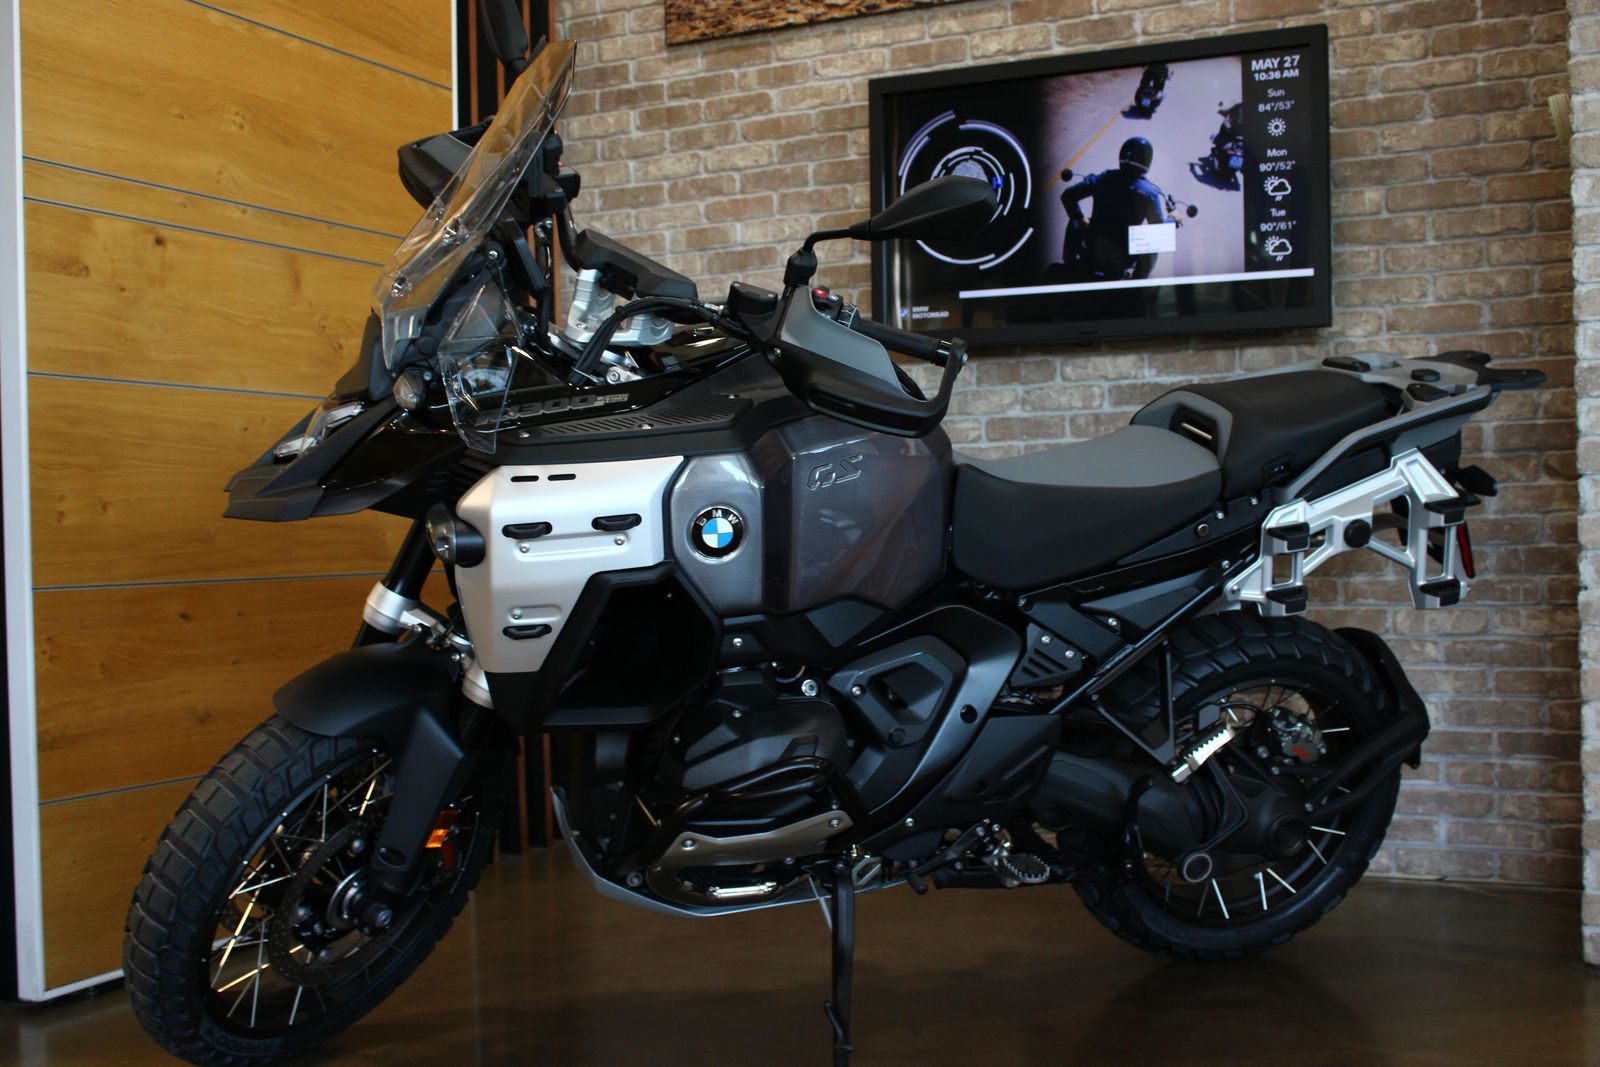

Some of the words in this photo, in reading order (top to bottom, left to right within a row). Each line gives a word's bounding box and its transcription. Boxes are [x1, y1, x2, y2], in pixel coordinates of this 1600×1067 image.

[1251, 57, 1280, 71] MAY
[1283, 54, 1300, 68] 27
[1254, 71, 1281, 81] 10:36
[1282, 69, 1299, 78] AM
[1267, 88, 1285, 97] Sun
[1266, 148, 1288, 157] Mon
[1270, 208, 1286, 217] Tue
[806, 455, 863, 491] GS
[696, 509, 740, 527] BMW
